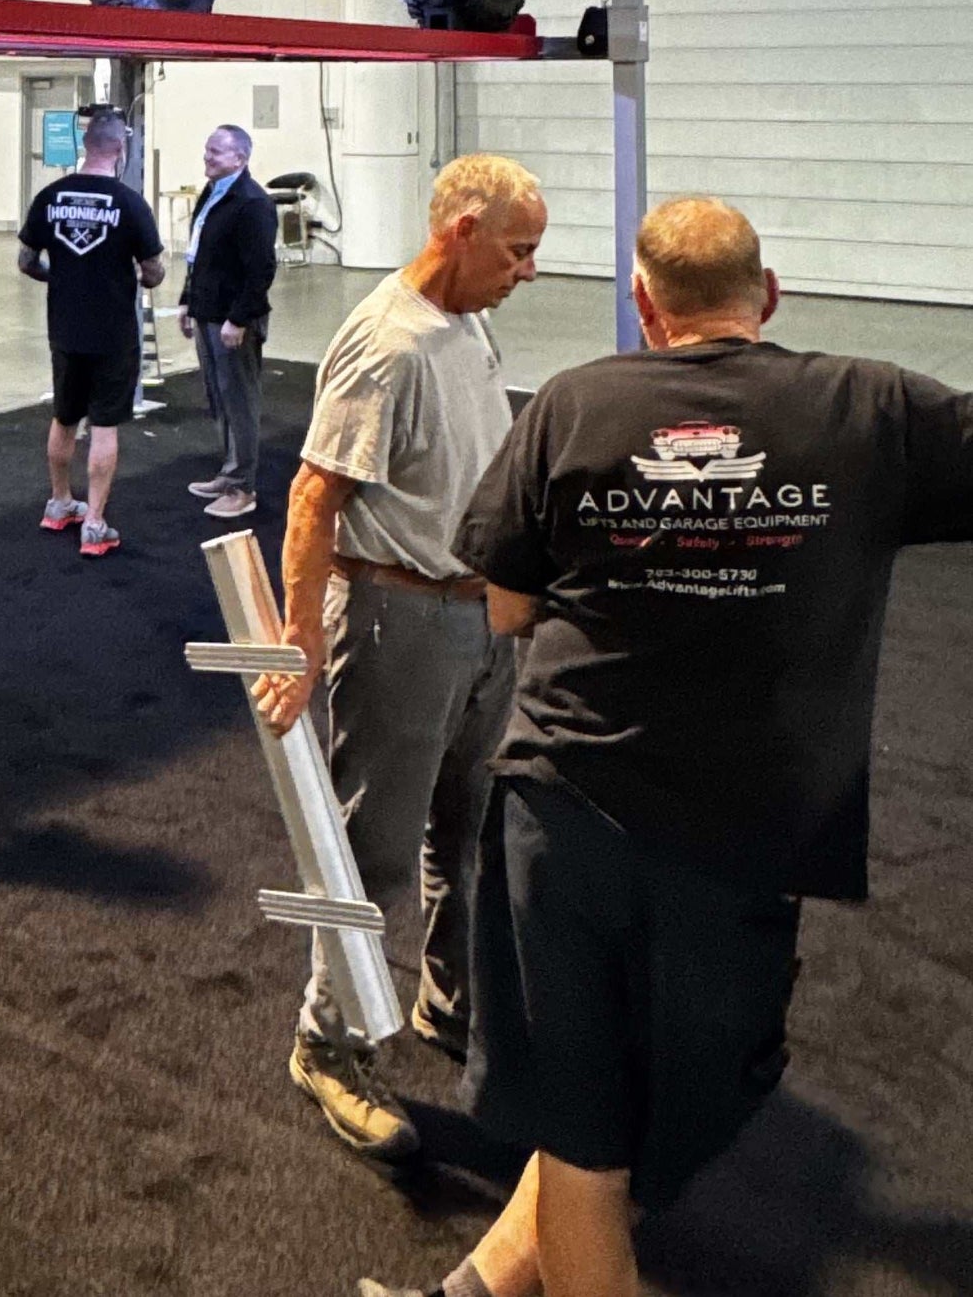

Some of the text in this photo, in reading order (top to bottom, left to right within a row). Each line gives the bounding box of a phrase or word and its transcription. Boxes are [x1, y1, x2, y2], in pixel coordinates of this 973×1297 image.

[577, 484, 831, 512] ADVANTAGE
[620, 516, 657, 530] AND
[660, 516, 729, 531] GARAGE
[734, 514, 830, 529] EQUIPMENT
